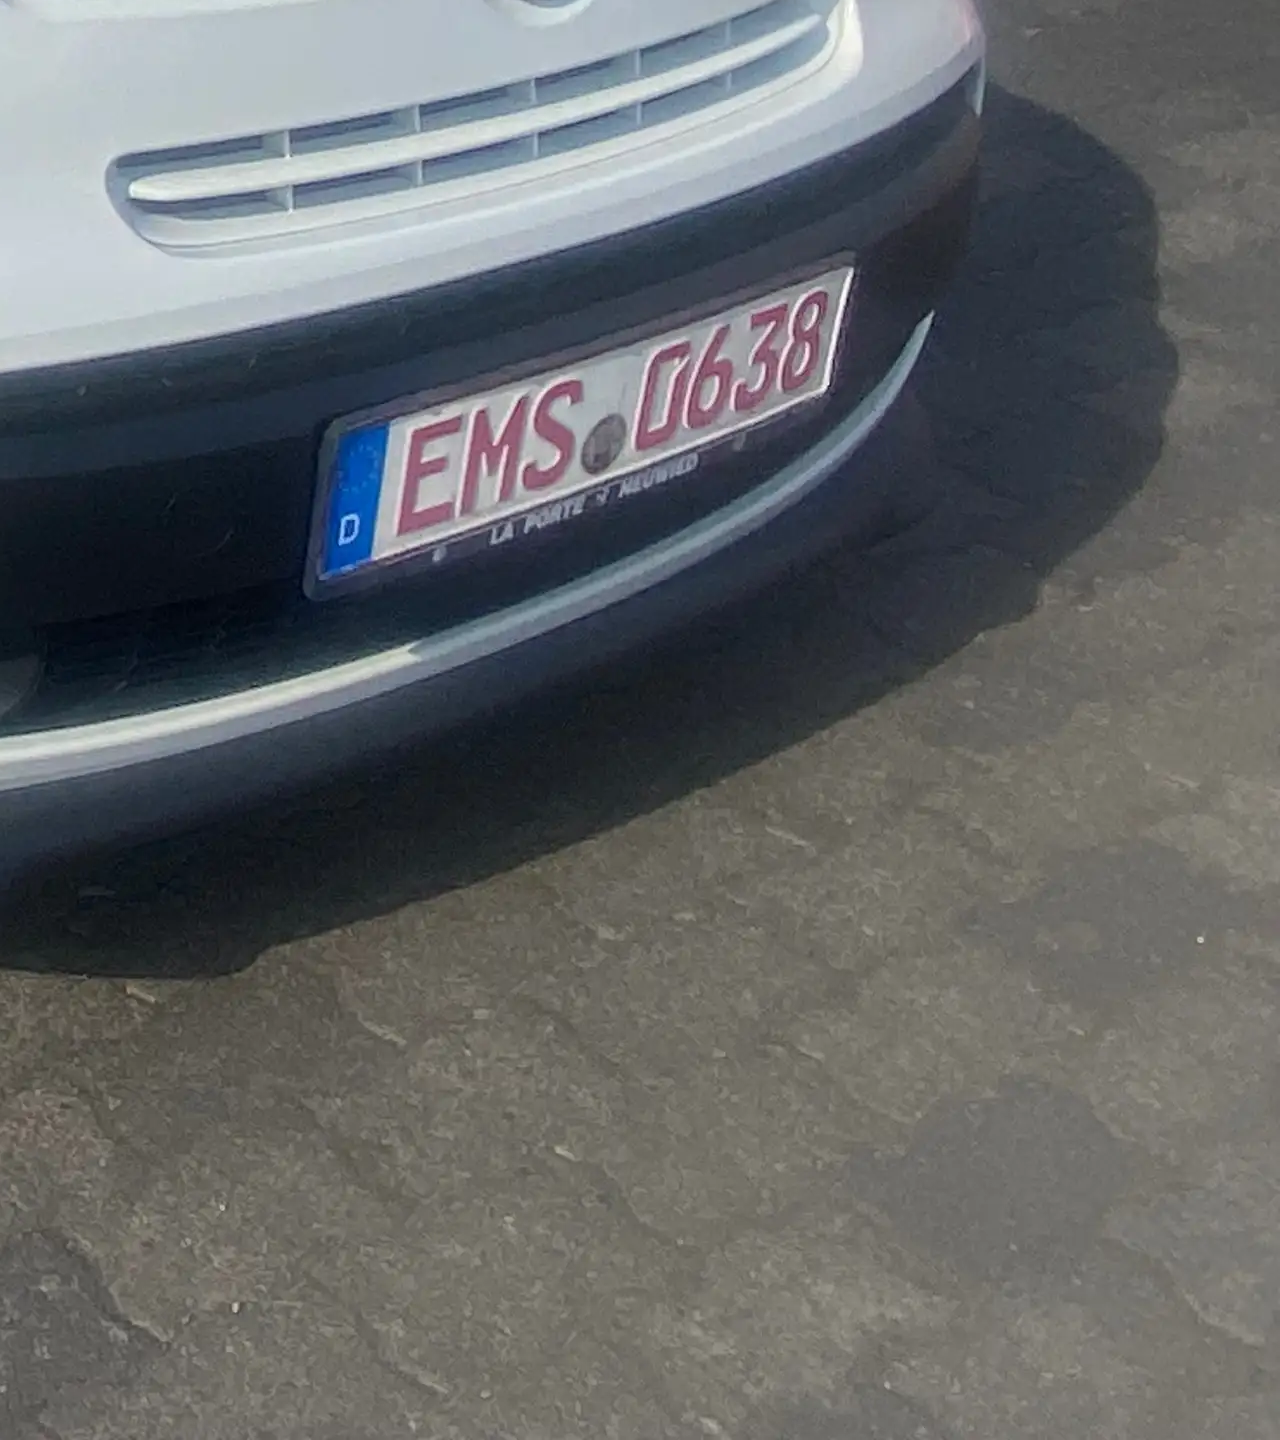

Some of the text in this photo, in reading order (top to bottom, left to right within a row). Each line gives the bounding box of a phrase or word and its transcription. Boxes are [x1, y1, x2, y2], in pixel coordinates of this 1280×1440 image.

[397, 289, 830, 537] EMS 0638
[338, 513, 360, 545] D
[490, 521, 514, 546] LA
